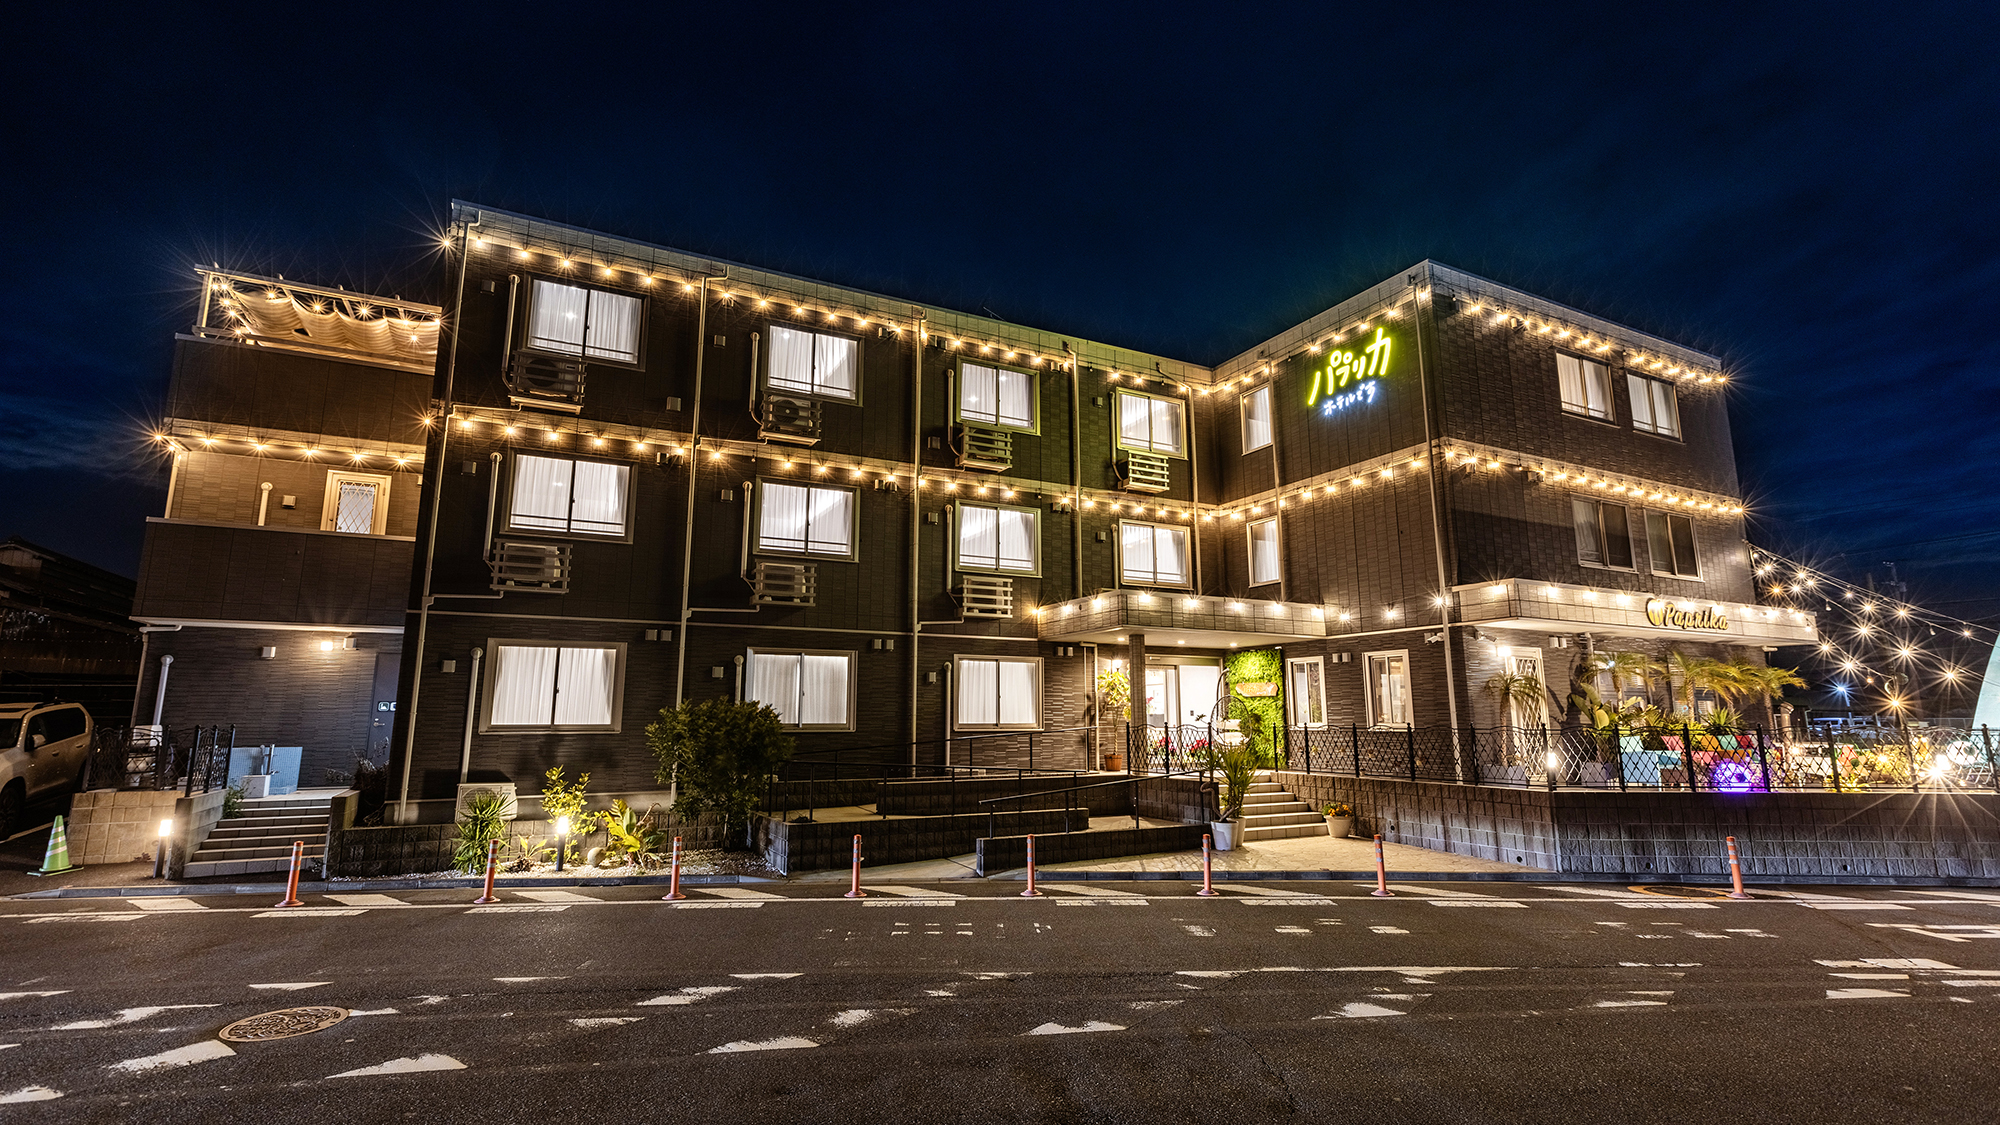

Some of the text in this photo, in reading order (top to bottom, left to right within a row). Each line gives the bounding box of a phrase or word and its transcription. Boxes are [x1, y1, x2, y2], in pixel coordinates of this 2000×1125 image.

[1308, 327, 1391, 405] パプリカ
[1664, 603, 1729, 630] Paprika
